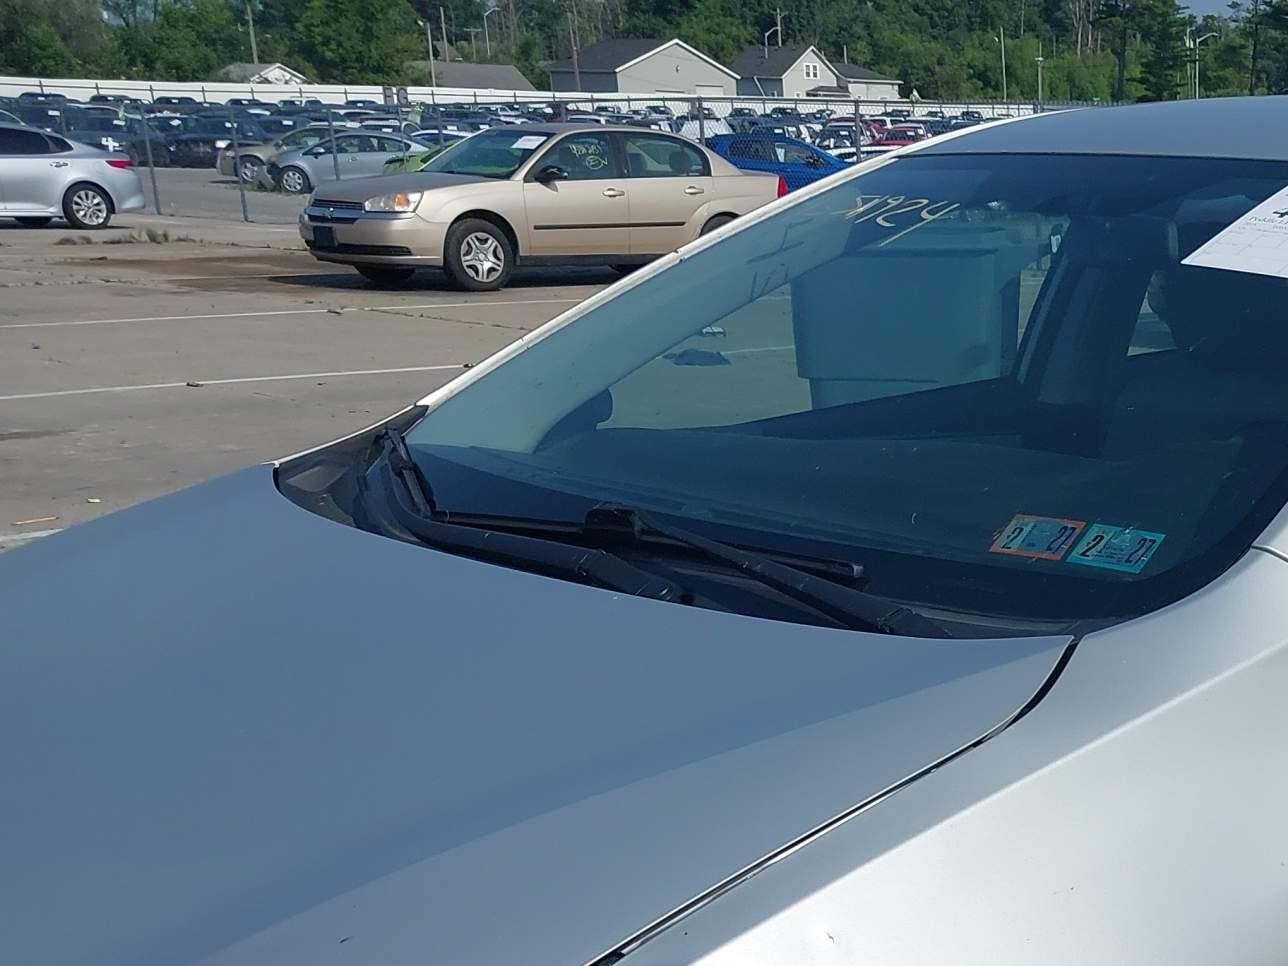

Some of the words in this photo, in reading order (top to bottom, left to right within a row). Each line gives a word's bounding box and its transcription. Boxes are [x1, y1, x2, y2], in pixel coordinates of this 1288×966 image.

[1001, 526, 1024, 550] 2
[1046, 525, 1077, 554] 27
[1079, 534, 1105, 557] 2
[1124, 537, 1157, 564] 27
